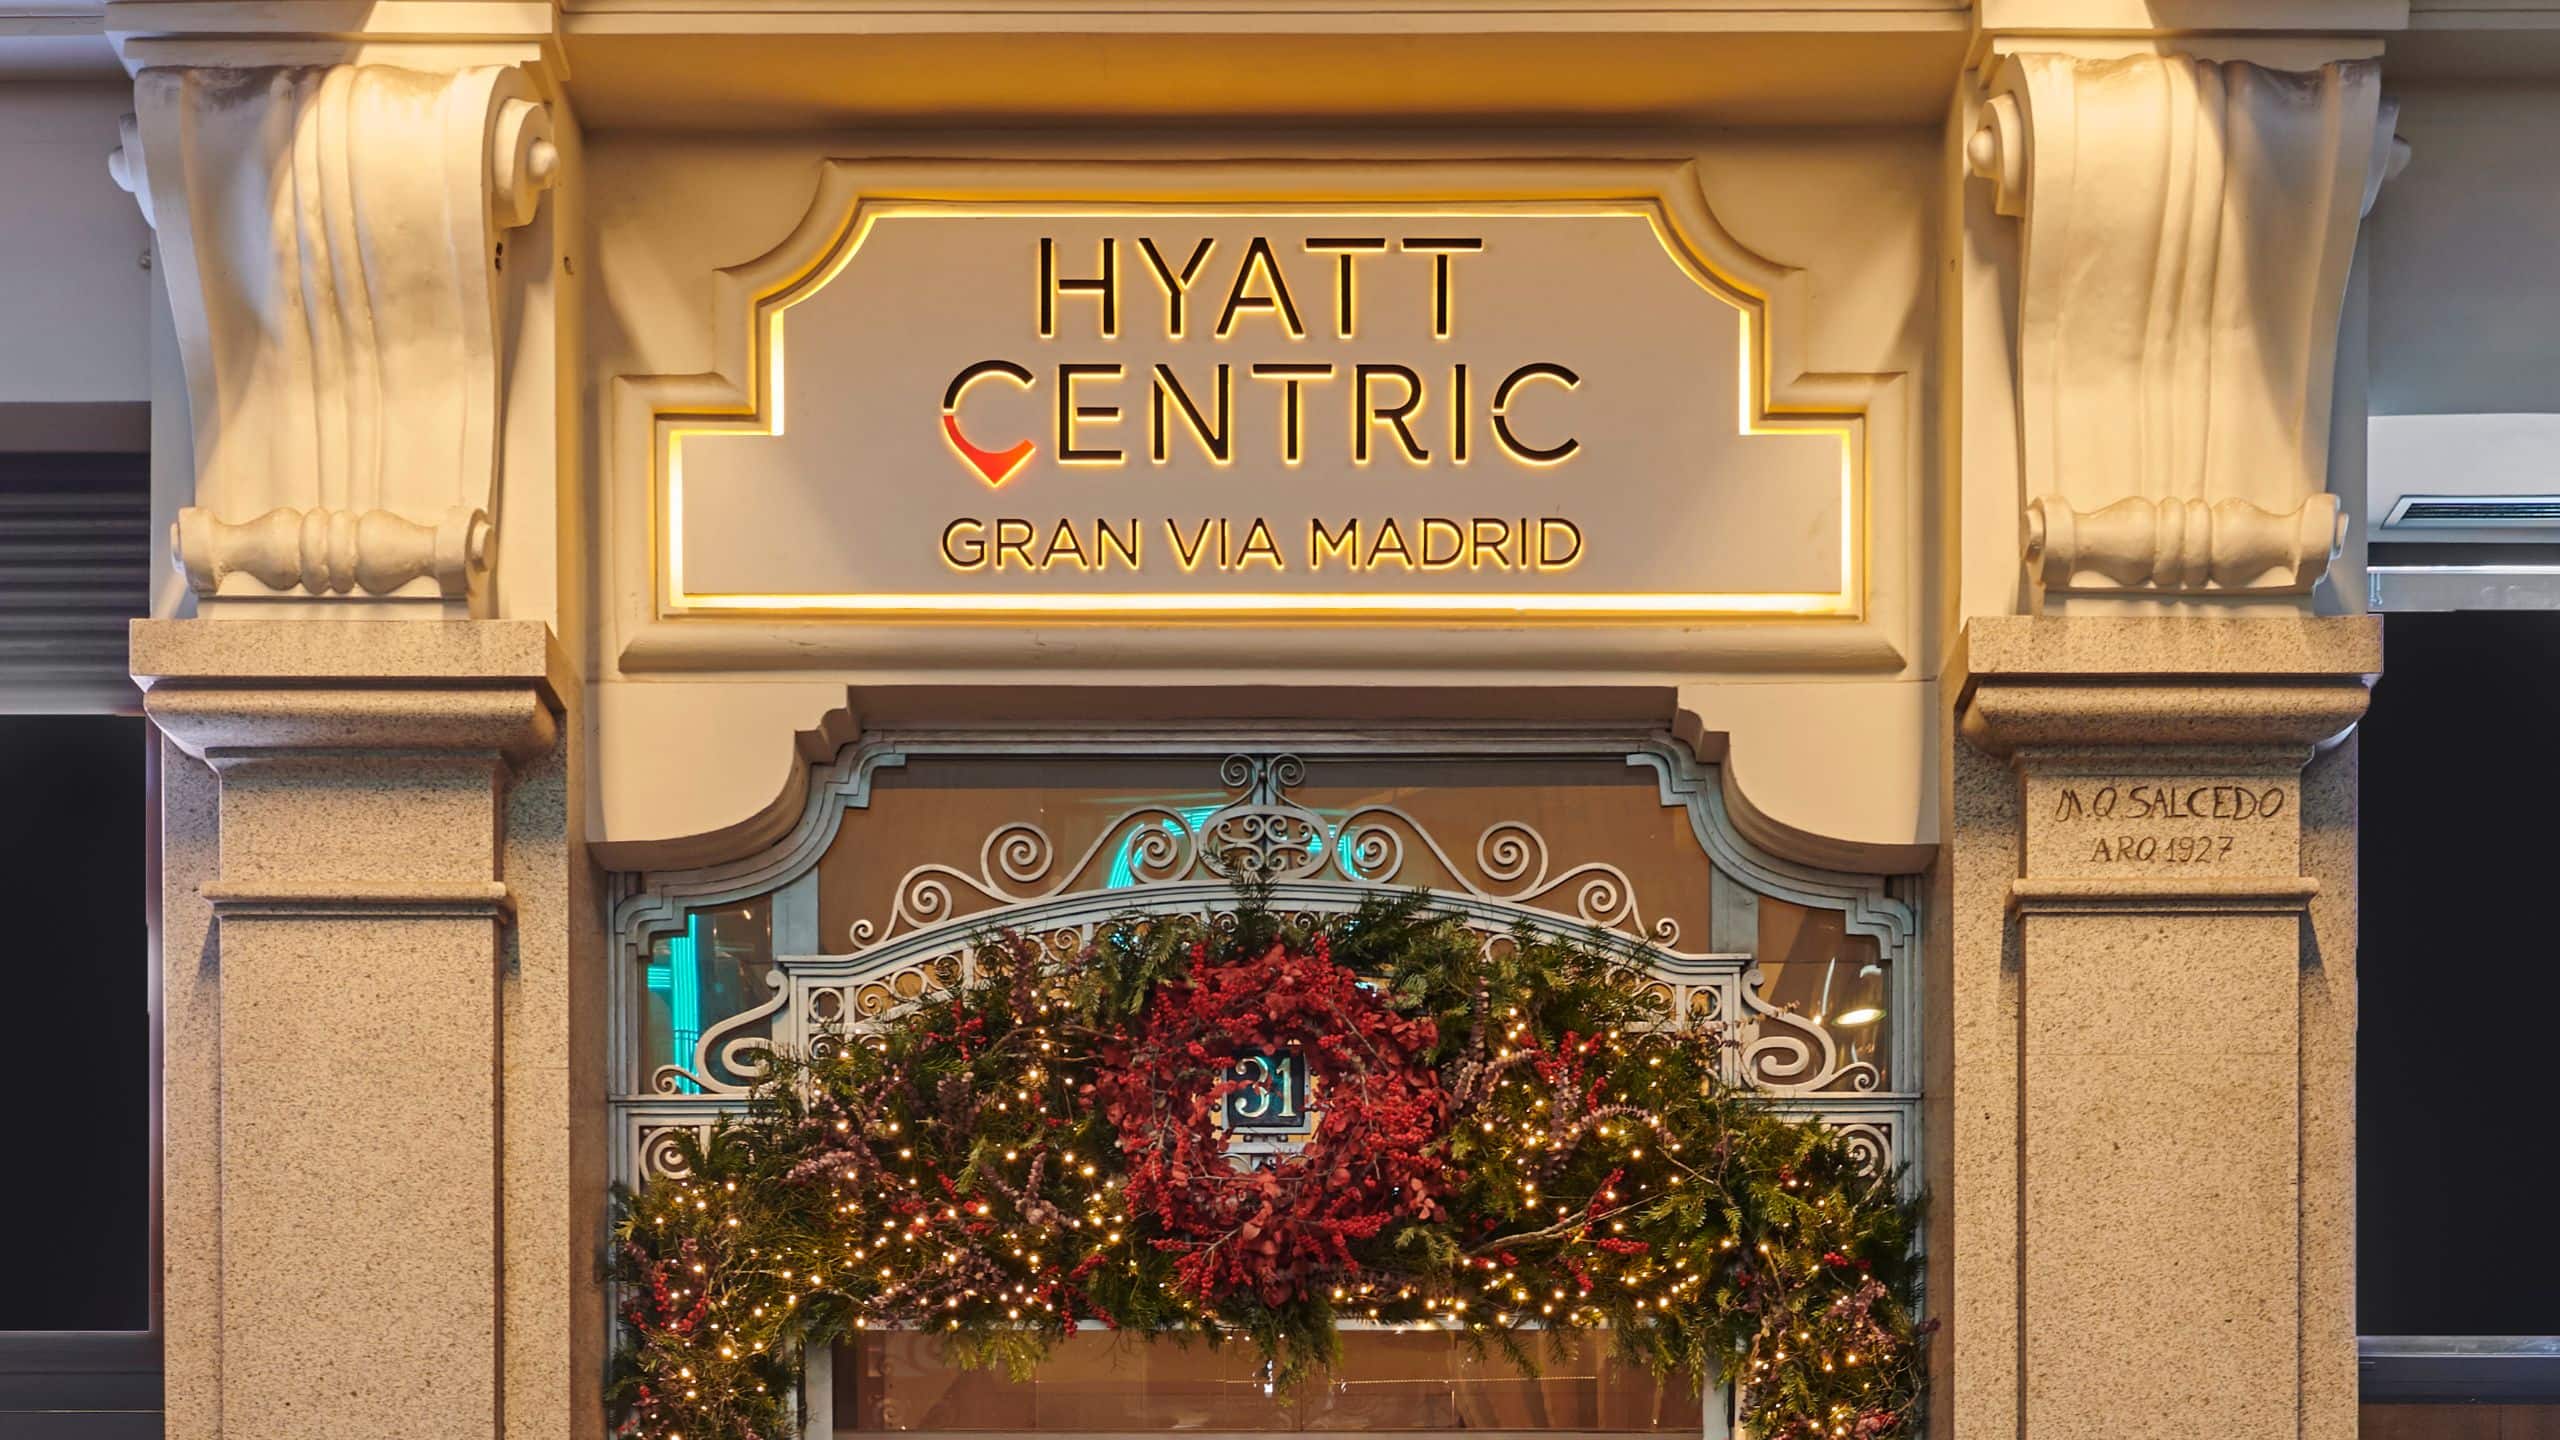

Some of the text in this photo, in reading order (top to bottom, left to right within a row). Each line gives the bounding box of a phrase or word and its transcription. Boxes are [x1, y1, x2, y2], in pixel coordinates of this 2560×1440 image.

[1039, 236, 1485, 340] HYATT
[942, 359, 1582, 488] CENTRIC
[941, 517, 1584, 571] GRAN VIA MADRID
[2124, 785, 2286, 821] SALCEDO
[2165, 836, 2235, 864] 1927
[1234, 1055, 1297, 1119] 31
